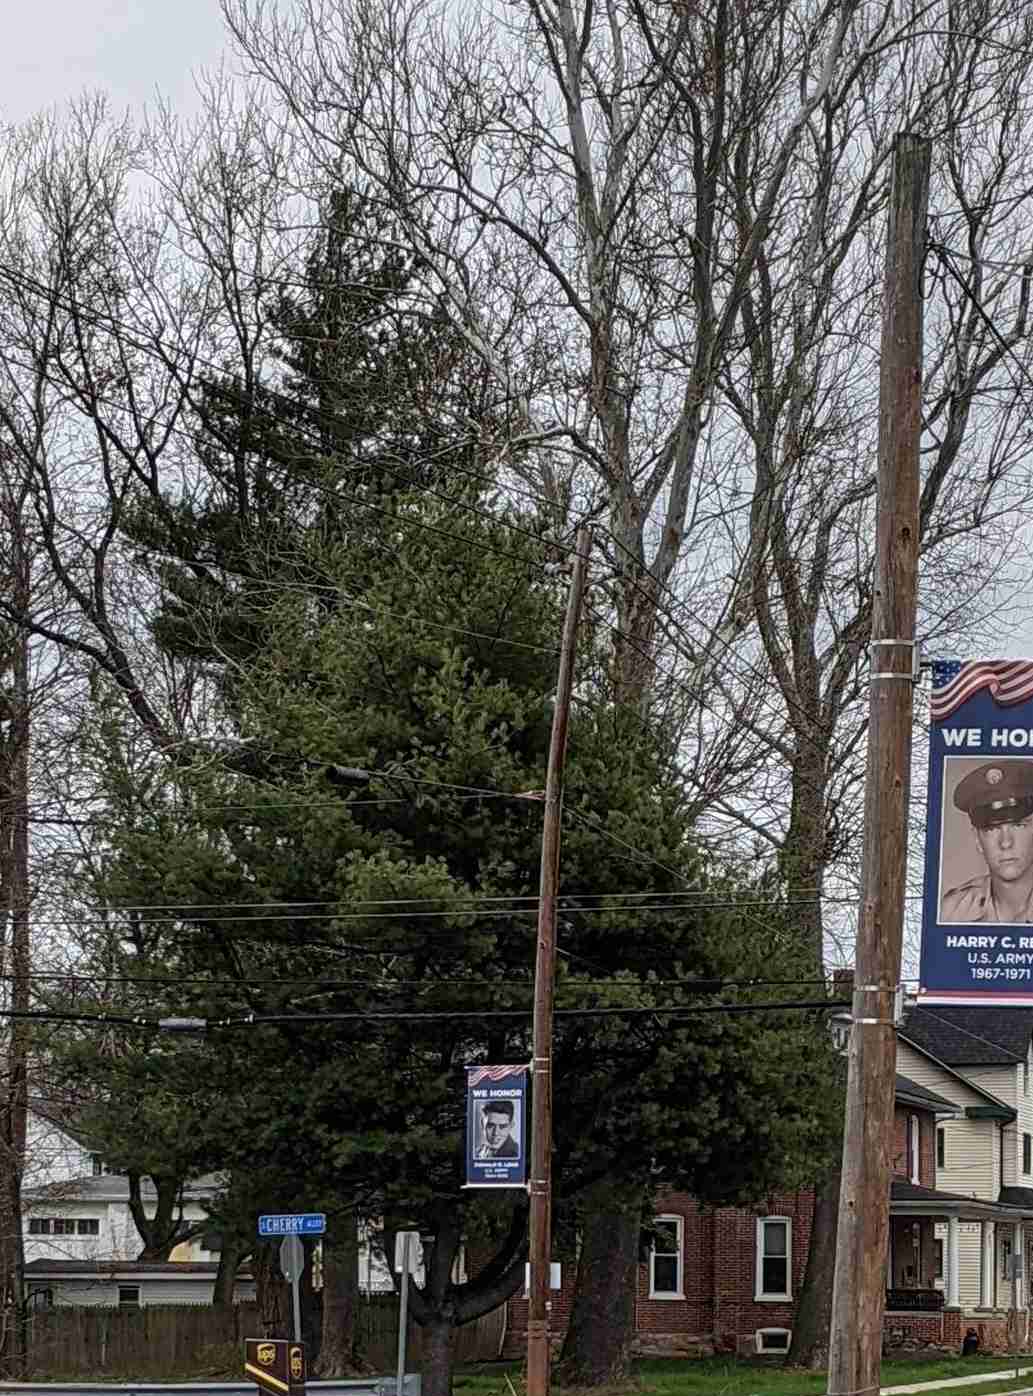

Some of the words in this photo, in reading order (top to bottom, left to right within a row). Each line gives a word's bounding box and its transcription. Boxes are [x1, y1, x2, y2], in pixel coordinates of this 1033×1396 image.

[942, 728, 982, 747] WE
[946, 935, 998, 949] HARRY
[1001, 936, 1016, 949] C.
[967, 952, 992, 964] U.S.
[971, 967, 1031, 980] 1967-1971
[472, 1089, 488, 1097] WE
[490, 1089, 523, 1098] HONOR
[266, 1217, 305, 1232] CHERRY
